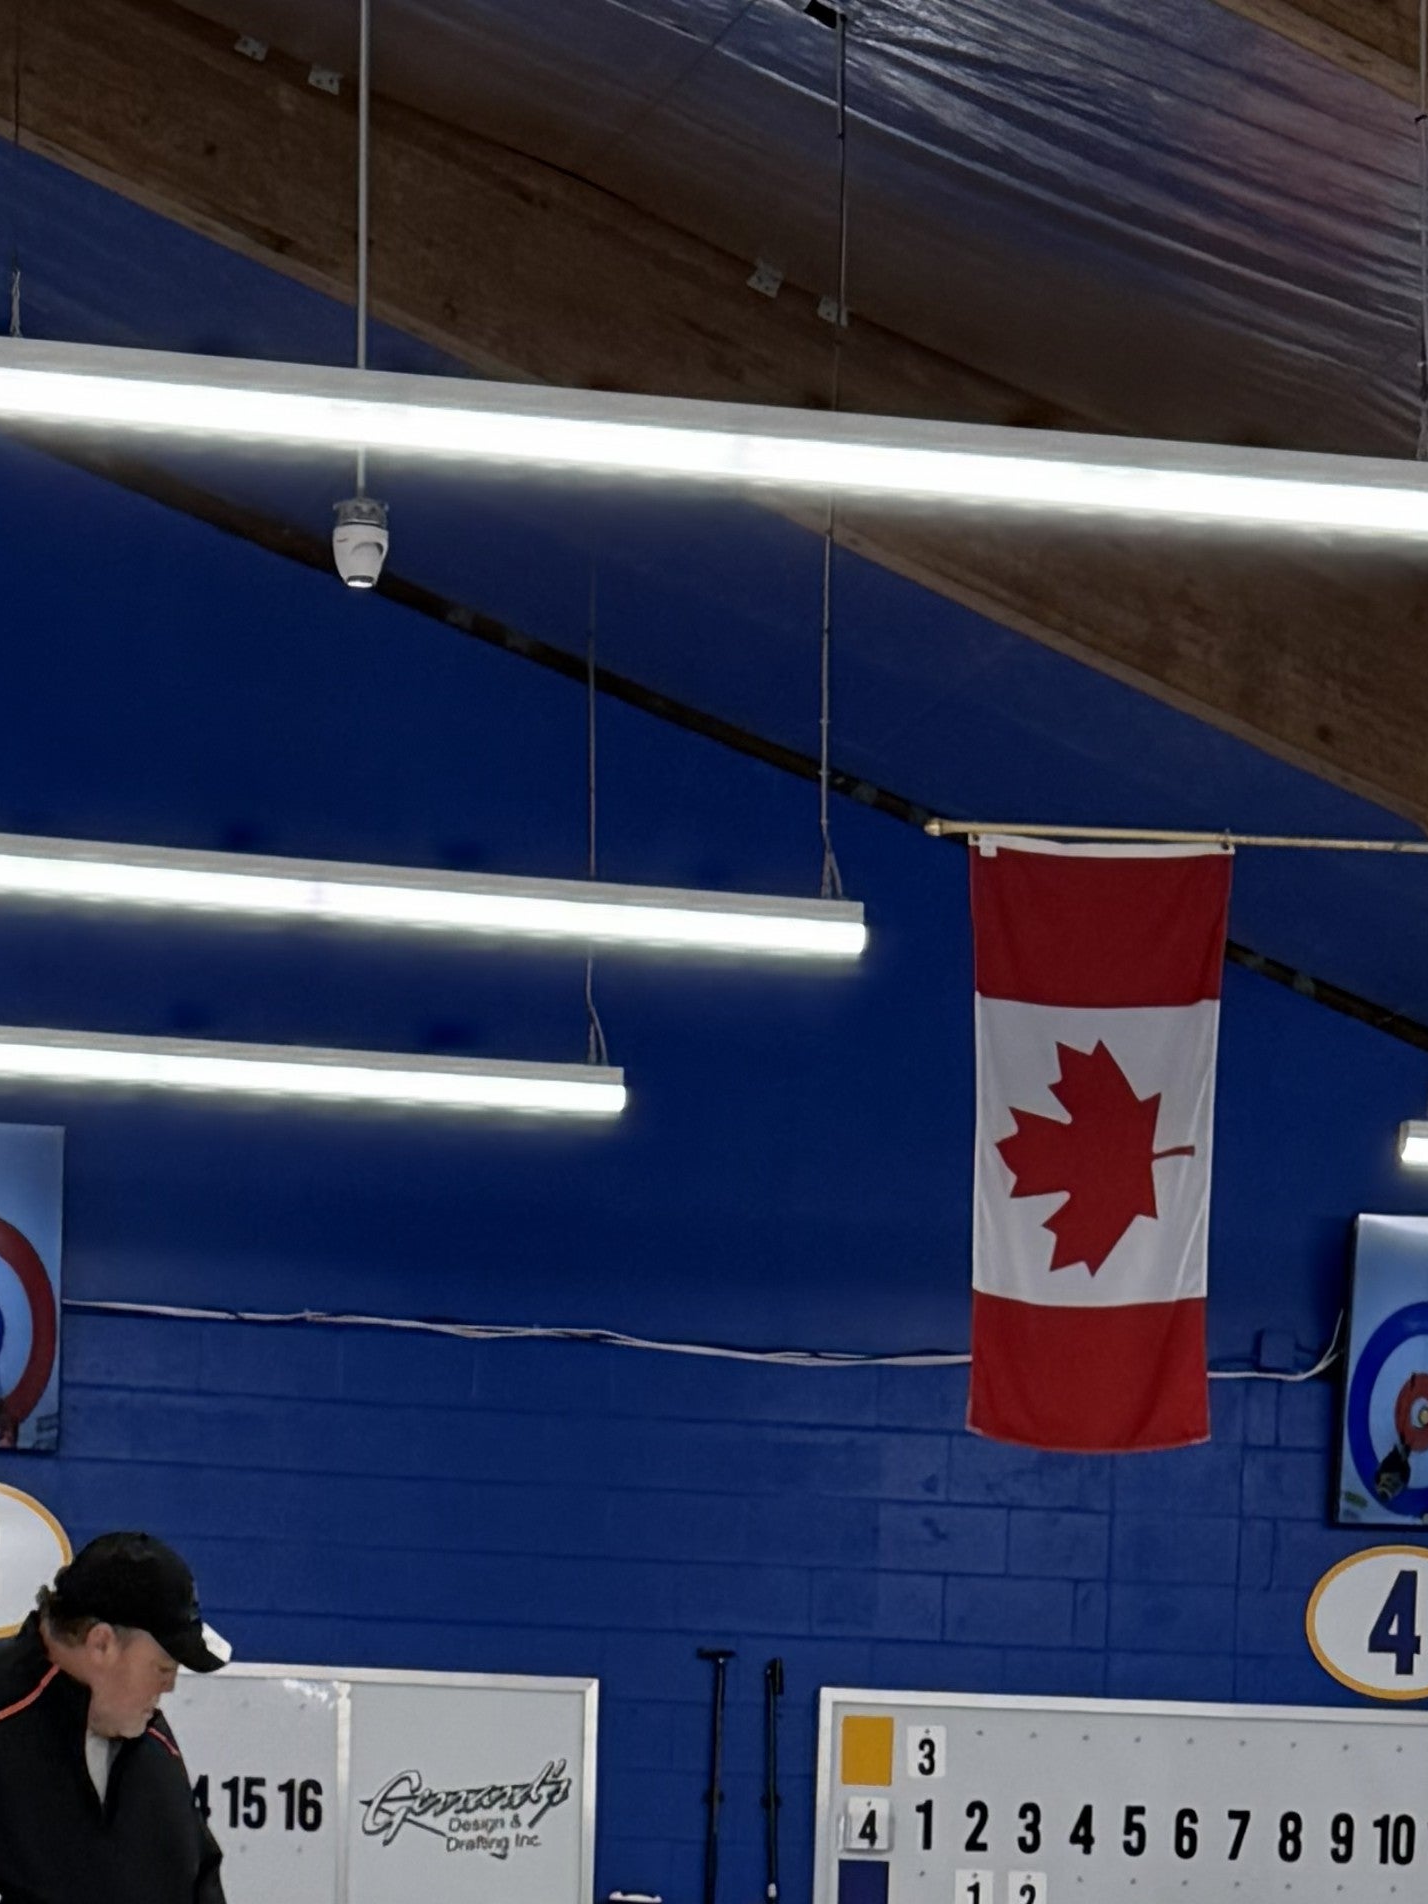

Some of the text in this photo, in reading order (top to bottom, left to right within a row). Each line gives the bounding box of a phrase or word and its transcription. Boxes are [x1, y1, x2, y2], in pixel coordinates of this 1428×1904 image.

[1367, 1569, 1421, 1676] 4
[917, 1737, 936, 1776] 3
[221, 1775, 267, 1830] 15
[277, 1778, 323, 1832] 16
[448, 1817, 505, 1834] Design
[858, 1809, 878, 1848] 4
[915, 1799, 933, 1851] 1
[964, 1800, 989, 1852] 2
[1017, 1802, 1042, 1854] 3
[1068, 1804, 1095, 1856] 4
[1122, 1805, 1147, 1857] 5
[1174, 1807, 1199, 1860] 6
[1227, 1809, 1251, 1861] 7
[1278, 1811, 1303, 1863] 8
[1330, 1812, 1355, 1864] 9
[1372, 1813, 1416, 1866] 10
